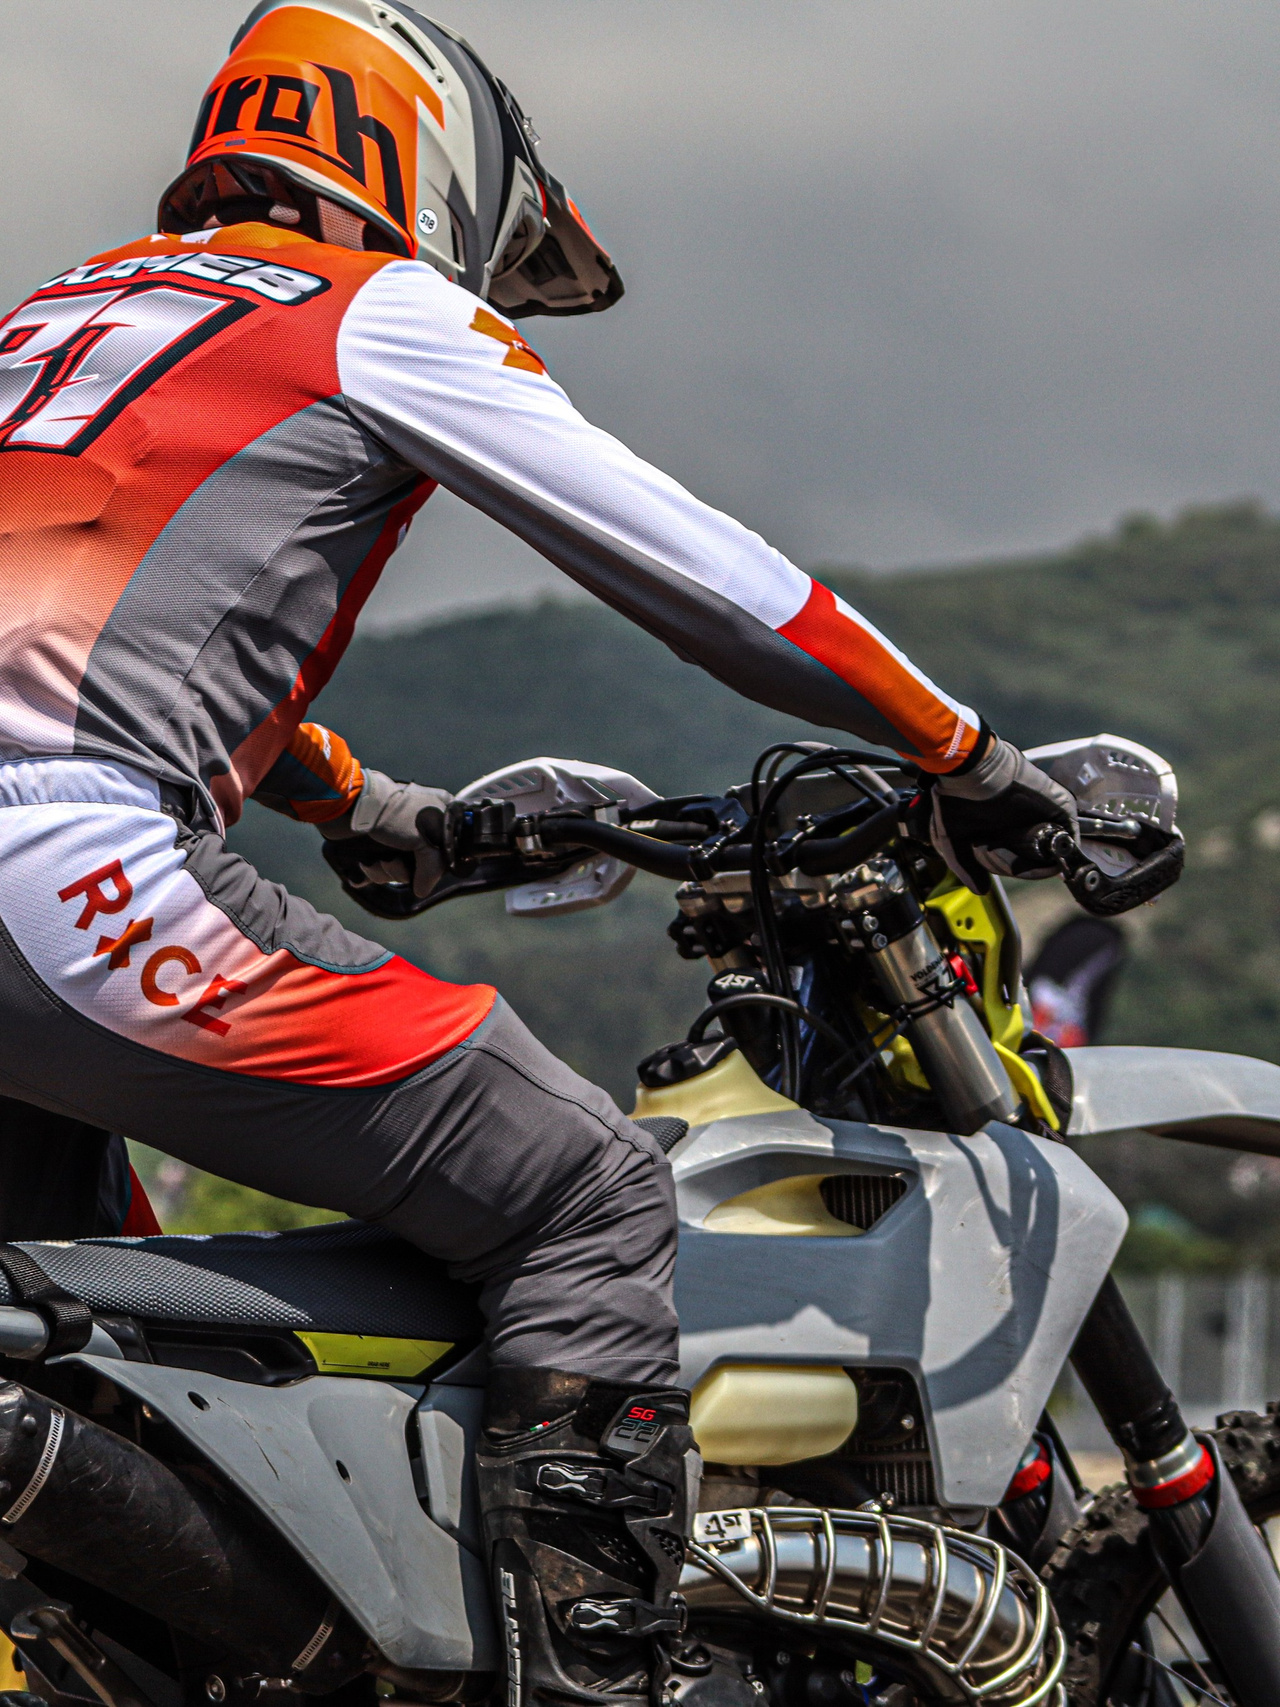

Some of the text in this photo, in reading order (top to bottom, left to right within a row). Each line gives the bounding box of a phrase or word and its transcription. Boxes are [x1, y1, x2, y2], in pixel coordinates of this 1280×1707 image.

[714, 973, 756, 989] 4ST
[627, 1406, 657, 1422] SG
[614, 1417, 661, 1444] 22
